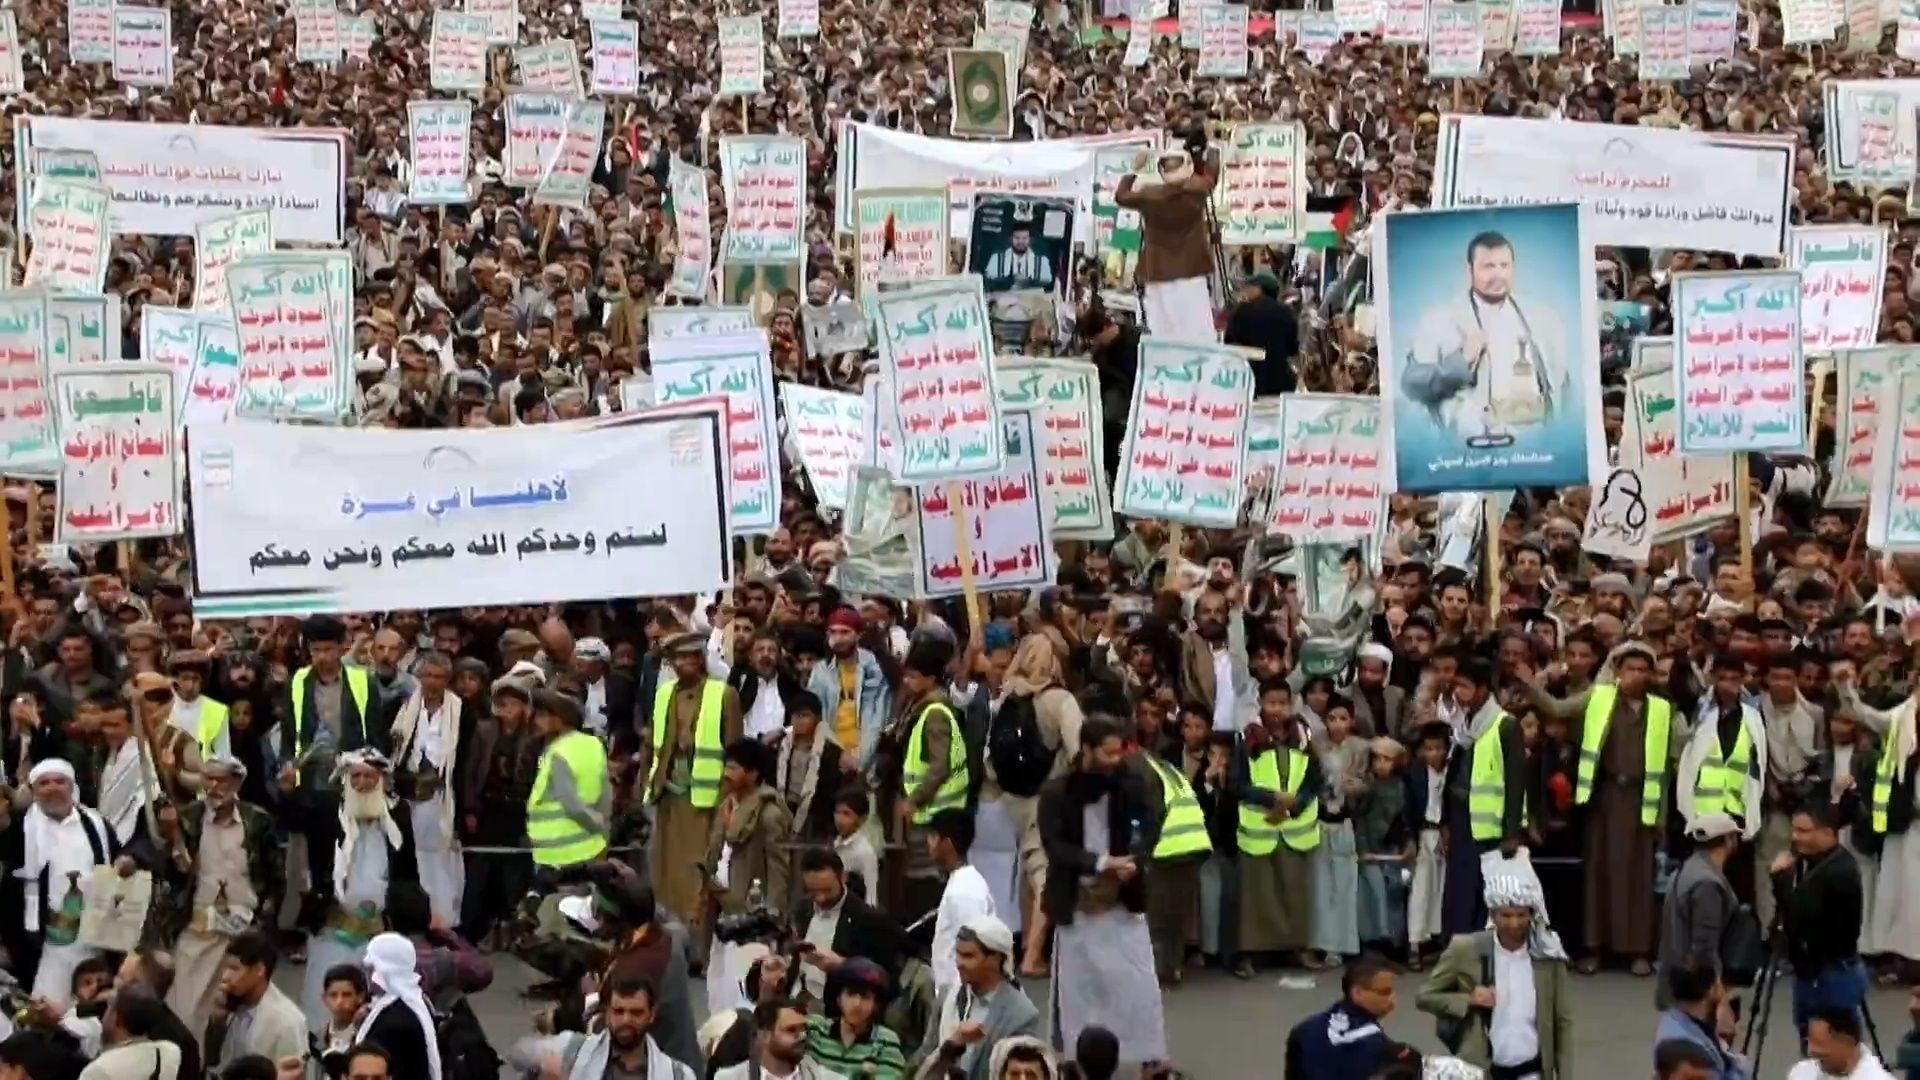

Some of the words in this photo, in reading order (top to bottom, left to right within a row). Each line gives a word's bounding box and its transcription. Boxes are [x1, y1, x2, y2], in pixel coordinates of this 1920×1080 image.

[1756, 288, 1795, 311] الله
[895, 303, 939, 343] أكبر
[946, 305, 978, 331] الله
[721, 366, 757, 393] الله
[1049, 376, 1085, 401] الله
[1211, 368, 1246, 390] الله
[65, 380, 163, 422] قاطعوا
[426, 486, 462, 516] في
[391, 535, 455, 568] معكم
[467, 532, 507, 558] الله
[516, 526, 597, 561] وحدكم
[605, 522, 668, 556] لستم
[248, 540, 312, 574] معكم
[322, 540, 384, 571] ونحن
